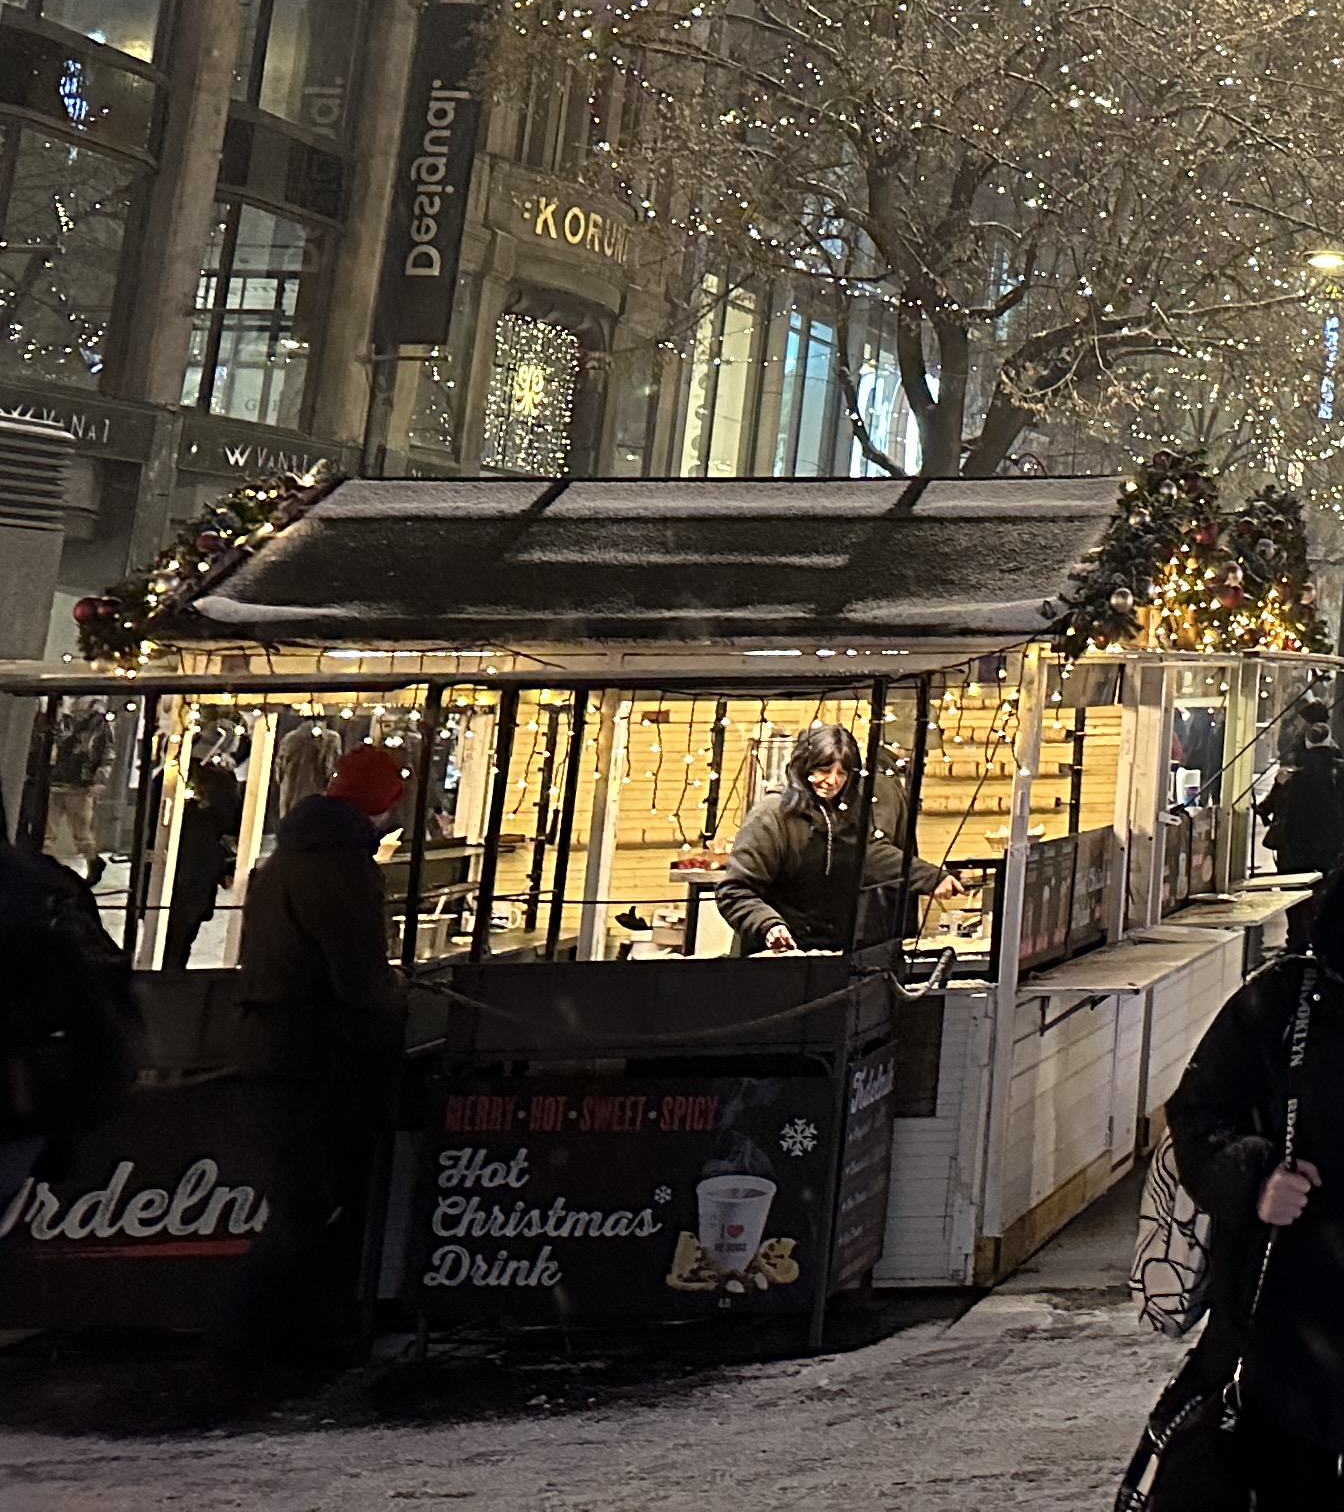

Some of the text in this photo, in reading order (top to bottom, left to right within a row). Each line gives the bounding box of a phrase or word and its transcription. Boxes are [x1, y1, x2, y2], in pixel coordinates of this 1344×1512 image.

[529, 1095, 568, 1132] HOT
[579, 1095, 648, 1132] SWEET
[659, 1095, 720, 1132] SPICY
[437, 1146, 531, 1189] Hot
[431, 1194, 663, 1239] Christmas
[423, 1244, 563, 1287] Drink
